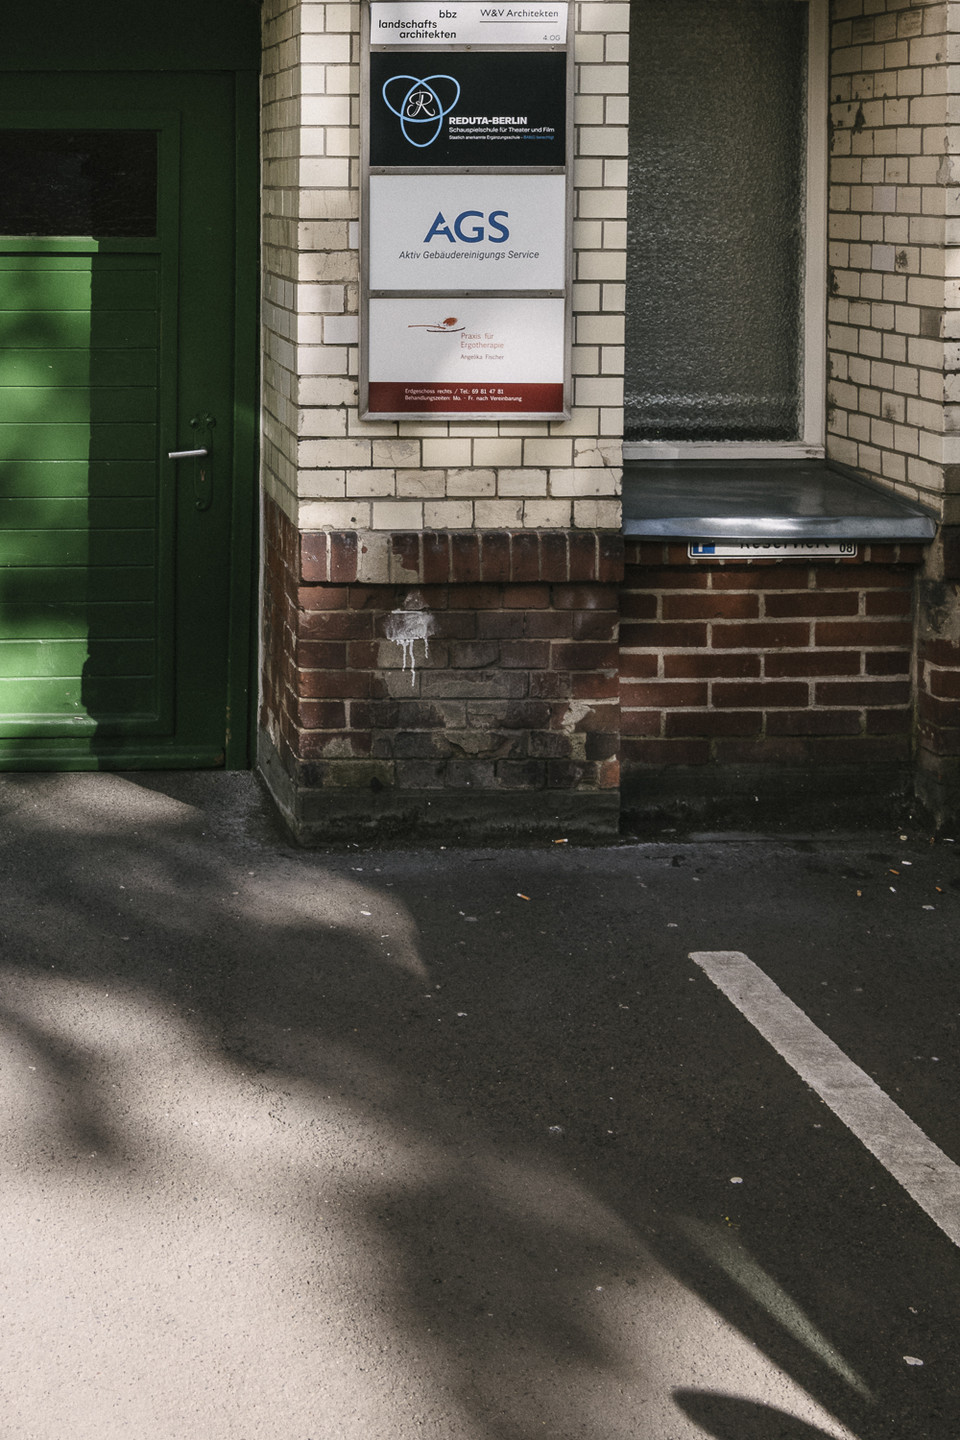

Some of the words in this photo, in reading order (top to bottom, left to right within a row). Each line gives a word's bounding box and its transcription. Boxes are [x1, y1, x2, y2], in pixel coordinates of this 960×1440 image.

[439, 10, 457, 19] bbz
[480, 9, 505, 17] W&V
[506, 9, 559, 18] Architekten
[378, 20, 438, 29] landschafts
[399, 30, 457, 39] architekten
[448, 117, 528, 125] REDUTA-BERLIN
[448, 126, 499, 134] Schauspielschule
[423, 210, 510, 243] AGS
[399, 251, 422, 259] Aktiv
[423, 250, 506, 260] Gebäudereinigungs
[508, 250, 540, 259] Service
[460, 332, 481, 340] Praxis
[484, 332, 494, 340] für
[460, 341, 504, 350] Ergotherapie
[839, 542, 853, 553] 08
